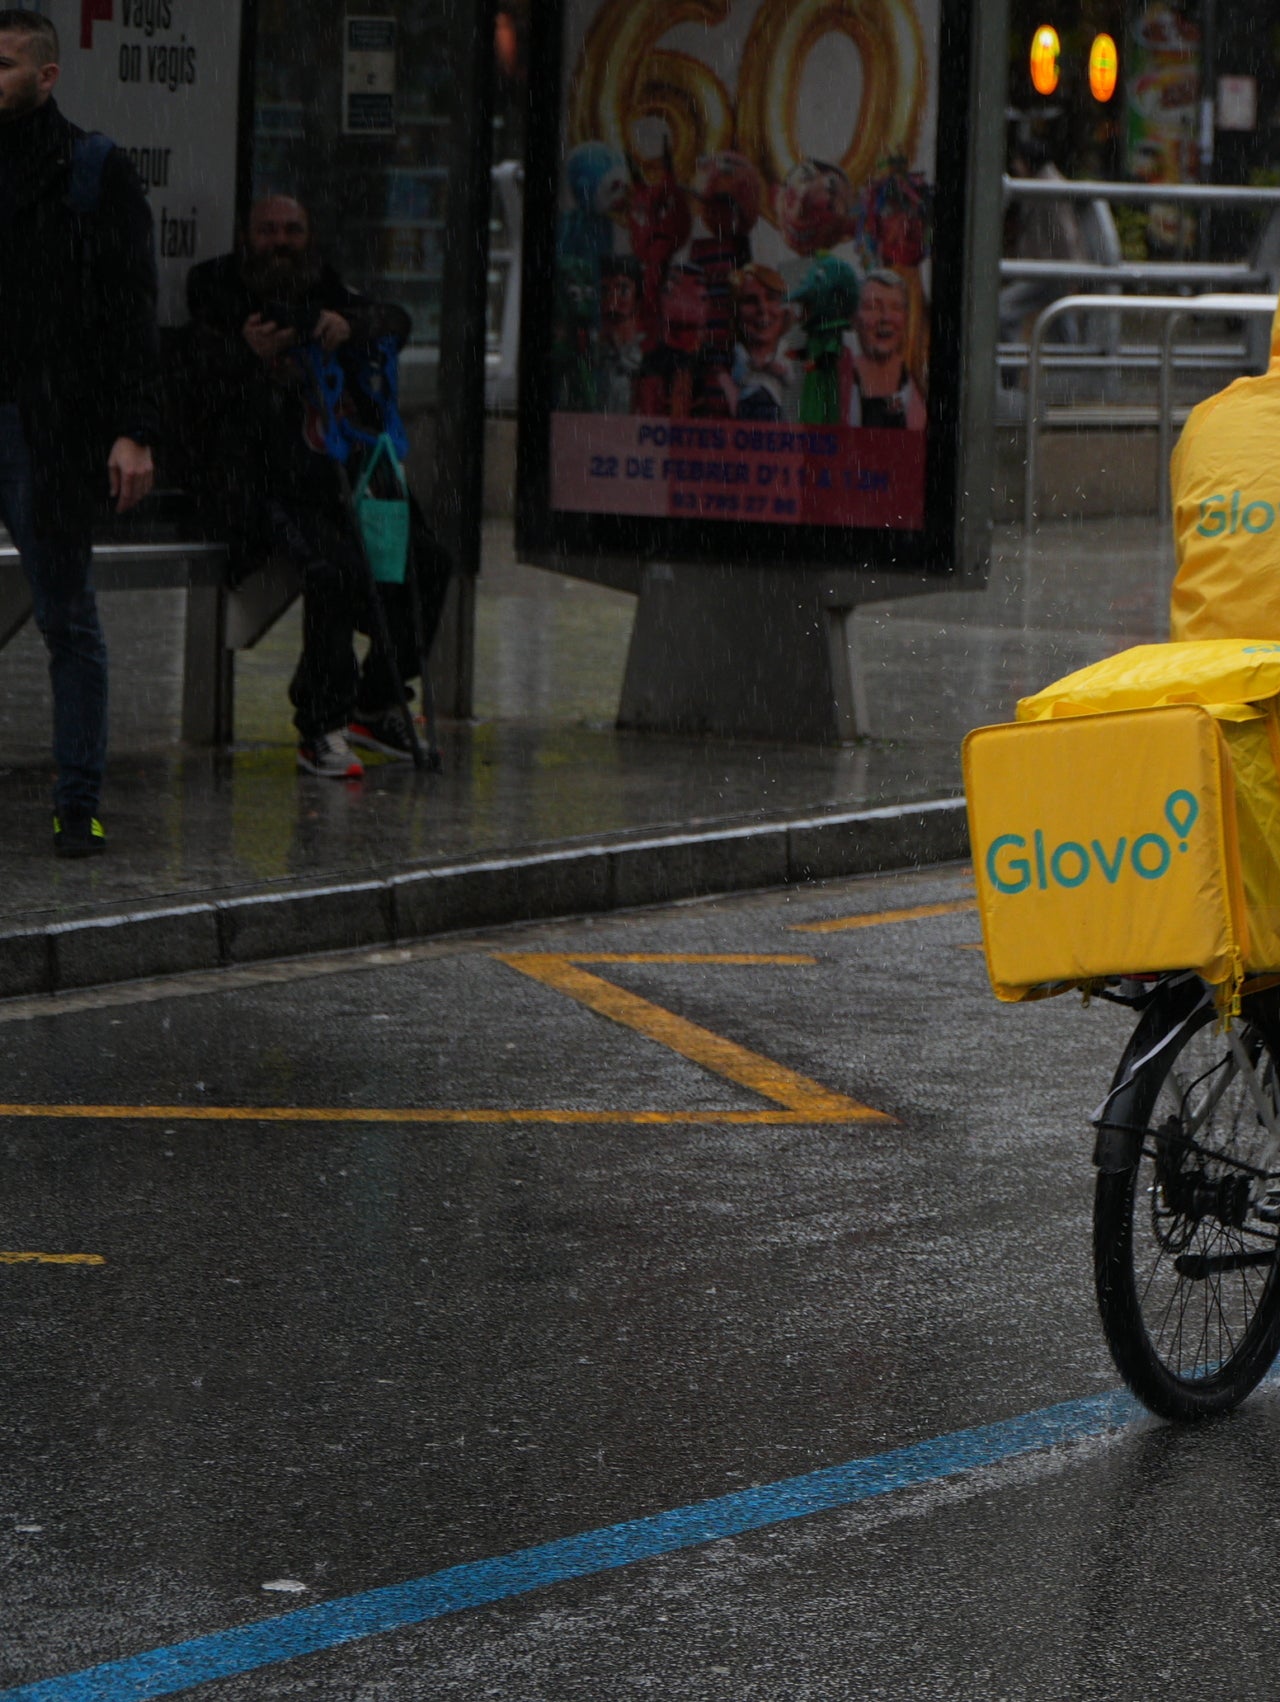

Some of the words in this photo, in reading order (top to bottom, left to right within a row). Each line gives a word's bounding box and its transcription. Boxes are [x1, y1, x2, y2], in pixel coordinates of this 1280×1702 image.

[119, 44, 141, 82] on
[147, 34, 196, 92] vagis
[160, 206, 197, 258] taxi
[637, 425, 726, 450] PORTES
[734, 429, 840, 456] OBERTES
[590, 455, 618, 478] 22
[626, 456, 654, 479] DE
[662, 459, 750, 483] FEBRER
[986, 828, 1172, 895] Glovo
